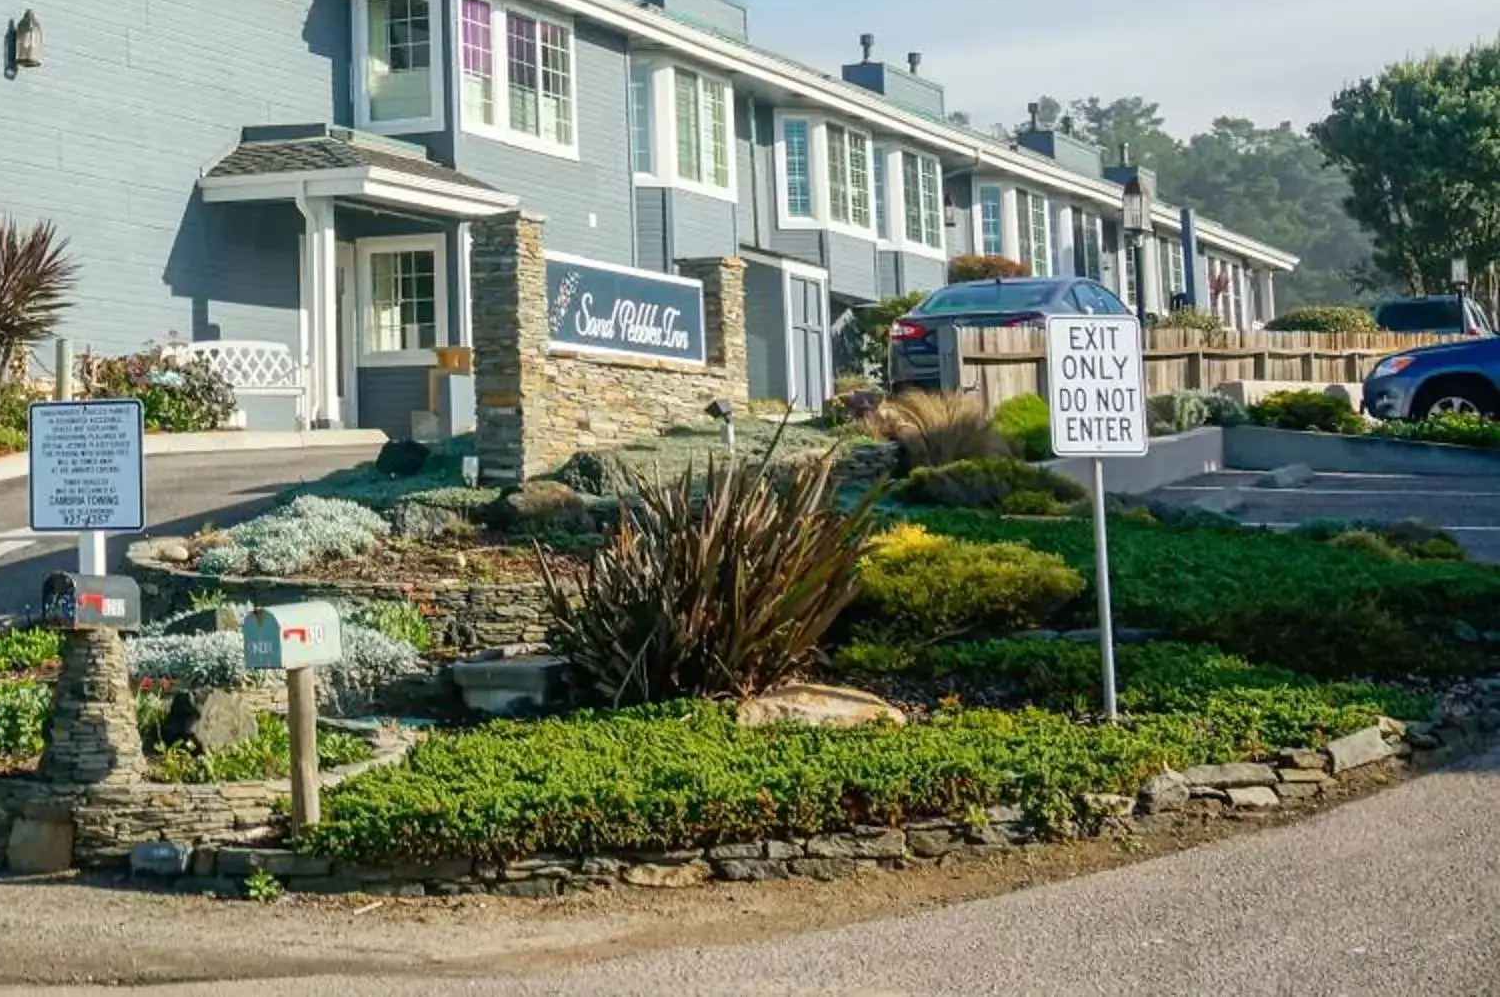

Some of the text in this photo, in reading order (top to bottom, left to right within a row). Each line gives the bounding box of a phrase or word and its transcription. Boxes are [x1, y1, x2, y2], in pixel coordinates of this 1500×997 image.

[576, 292, 688, 349] Sand Pebbles Inn
[1069, 326, 1119, 350] EXIT
[1062, 355, 1128, 380] ONLY
[1060, 388, 1137, 412] DO NOT
[1067, 417, 1133, 441] ENTER
